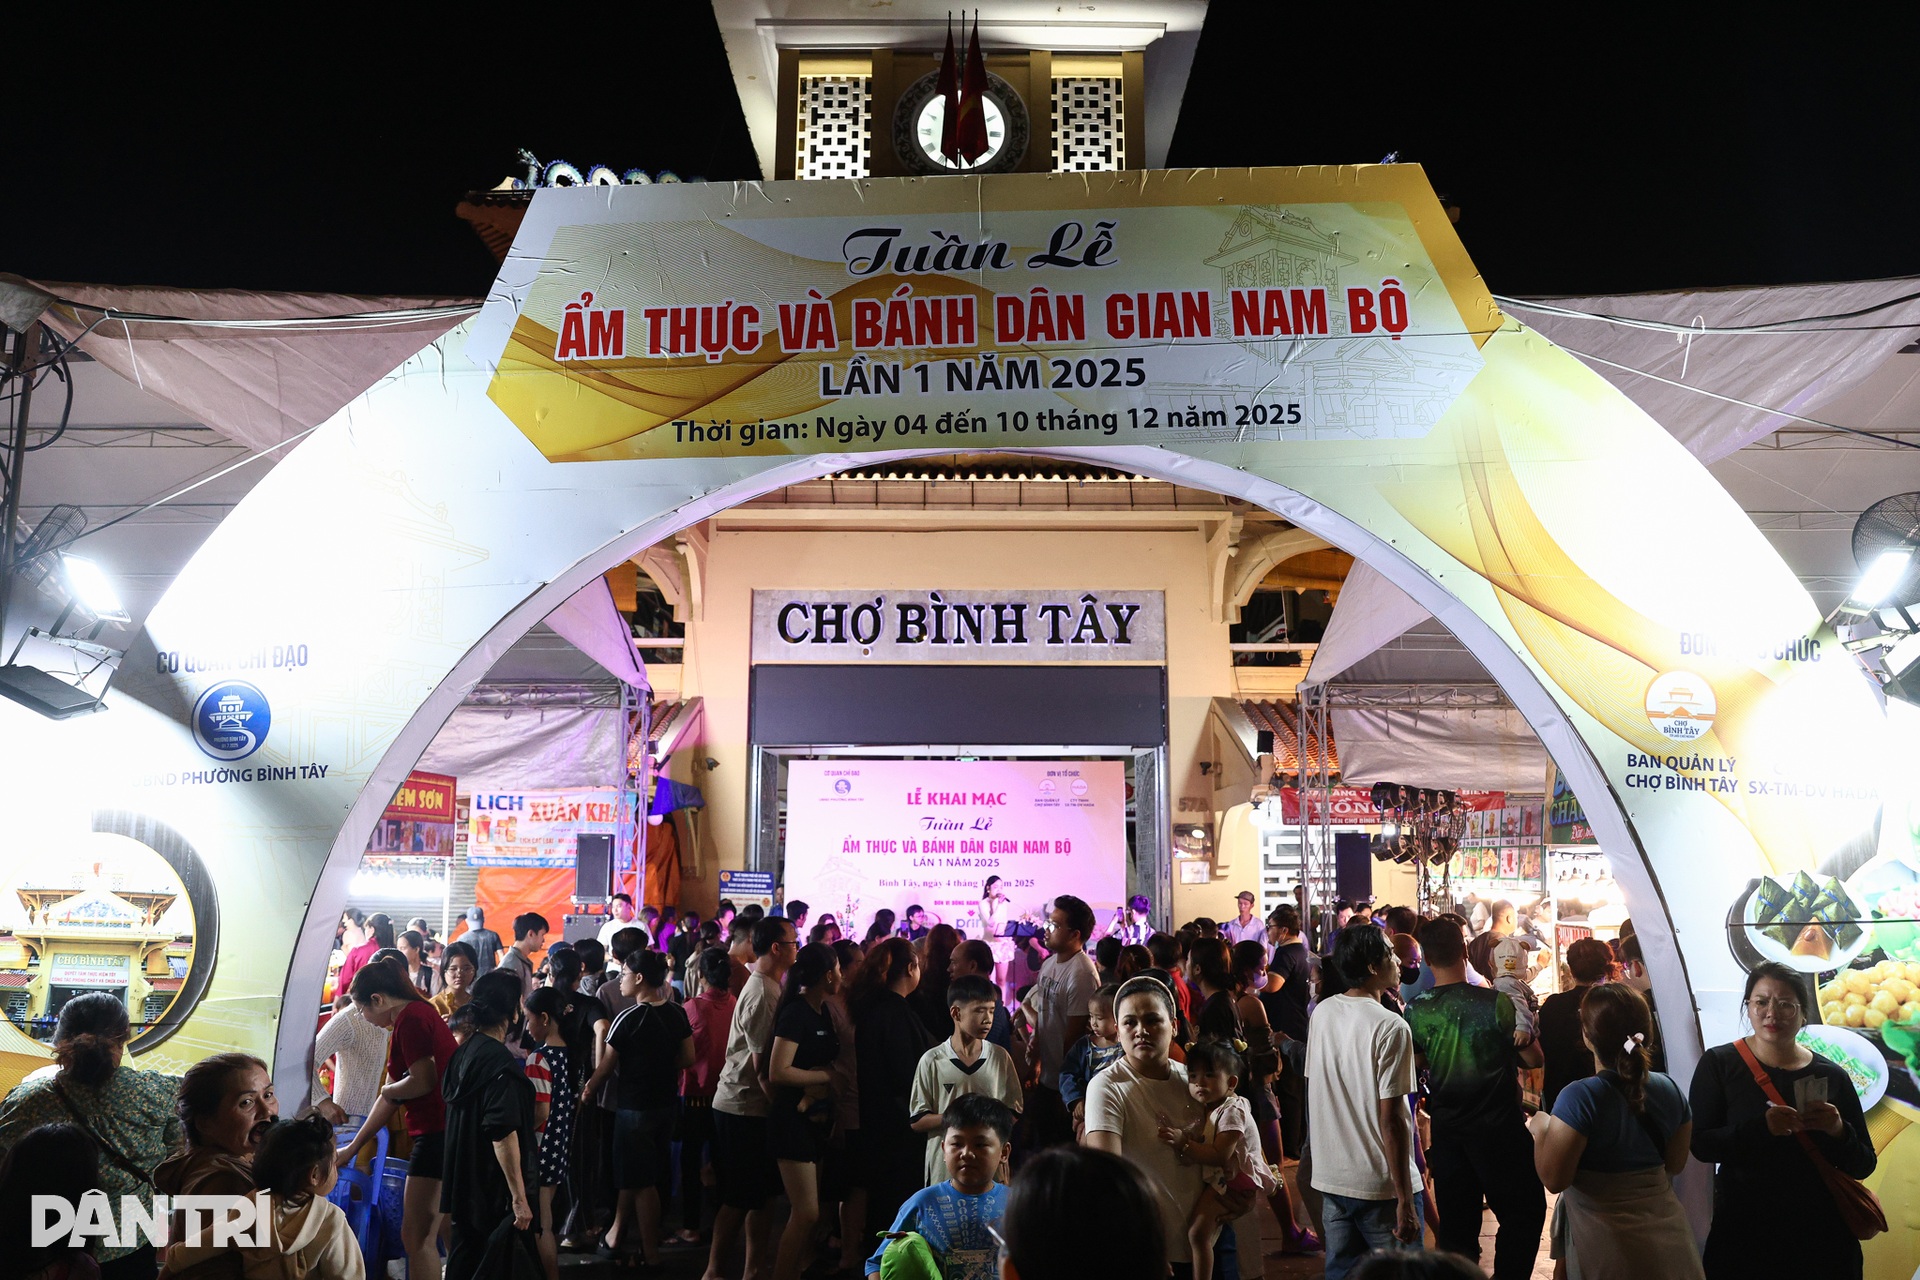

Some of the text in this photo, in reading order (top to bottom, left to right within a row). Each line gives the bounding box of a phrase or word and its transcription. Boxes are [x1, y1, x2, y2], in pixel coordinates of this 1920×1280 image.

[843, 220, 1118, 275] Tuần Lễ
[558, 278, 1408, 360] ẨM THỰC VÀ BÁNH DÂN GIAN NAM BỘ
[821, 354, 1147, 396] LẦN 1 NĂM 2025
[671, 403, 1302, 447] Thời gian: Ngày 04 đến 10 tháng 12 năm 2025
[777, 592, 1140, 656] CHỢ BÌNH TÂY
[272, 644, 308, 671] ĐẠO
[1773, 634, 1821, 662] CHỨC
[1664, 725, 1683, 734] BÌNH
[1684, 726, 1700, 735] TÂY
[181, 767, 253, 785] PHƯỜNG
[257, 763, 296, 782] BÌNH
[299, 761, 329, 780] TÂY
[1627, 753, 1737, 773] BAN QUẢN LÝ
[1625, 774, 1738, 793] CHỢ BÌNH TÂY
[419, 789, 444, 810] SƠN
[476, 794, 524, 814] LỊCH
[529, 796, 581, 822] XUÂN
[907, 787, 1007, 808] LỄ KHAI MẠC
[842, 834, 1071, 856] ẨM THỰC VÀ BÁNH DÂN GIAN NAM BỘ
[913, 856, 999, 867] LẦN 1 NĂM 2025
[946, 879, 951, 887] 4
[953, 879, 978, 888] tháng
[1014, 879, 1035, 887] 2025
